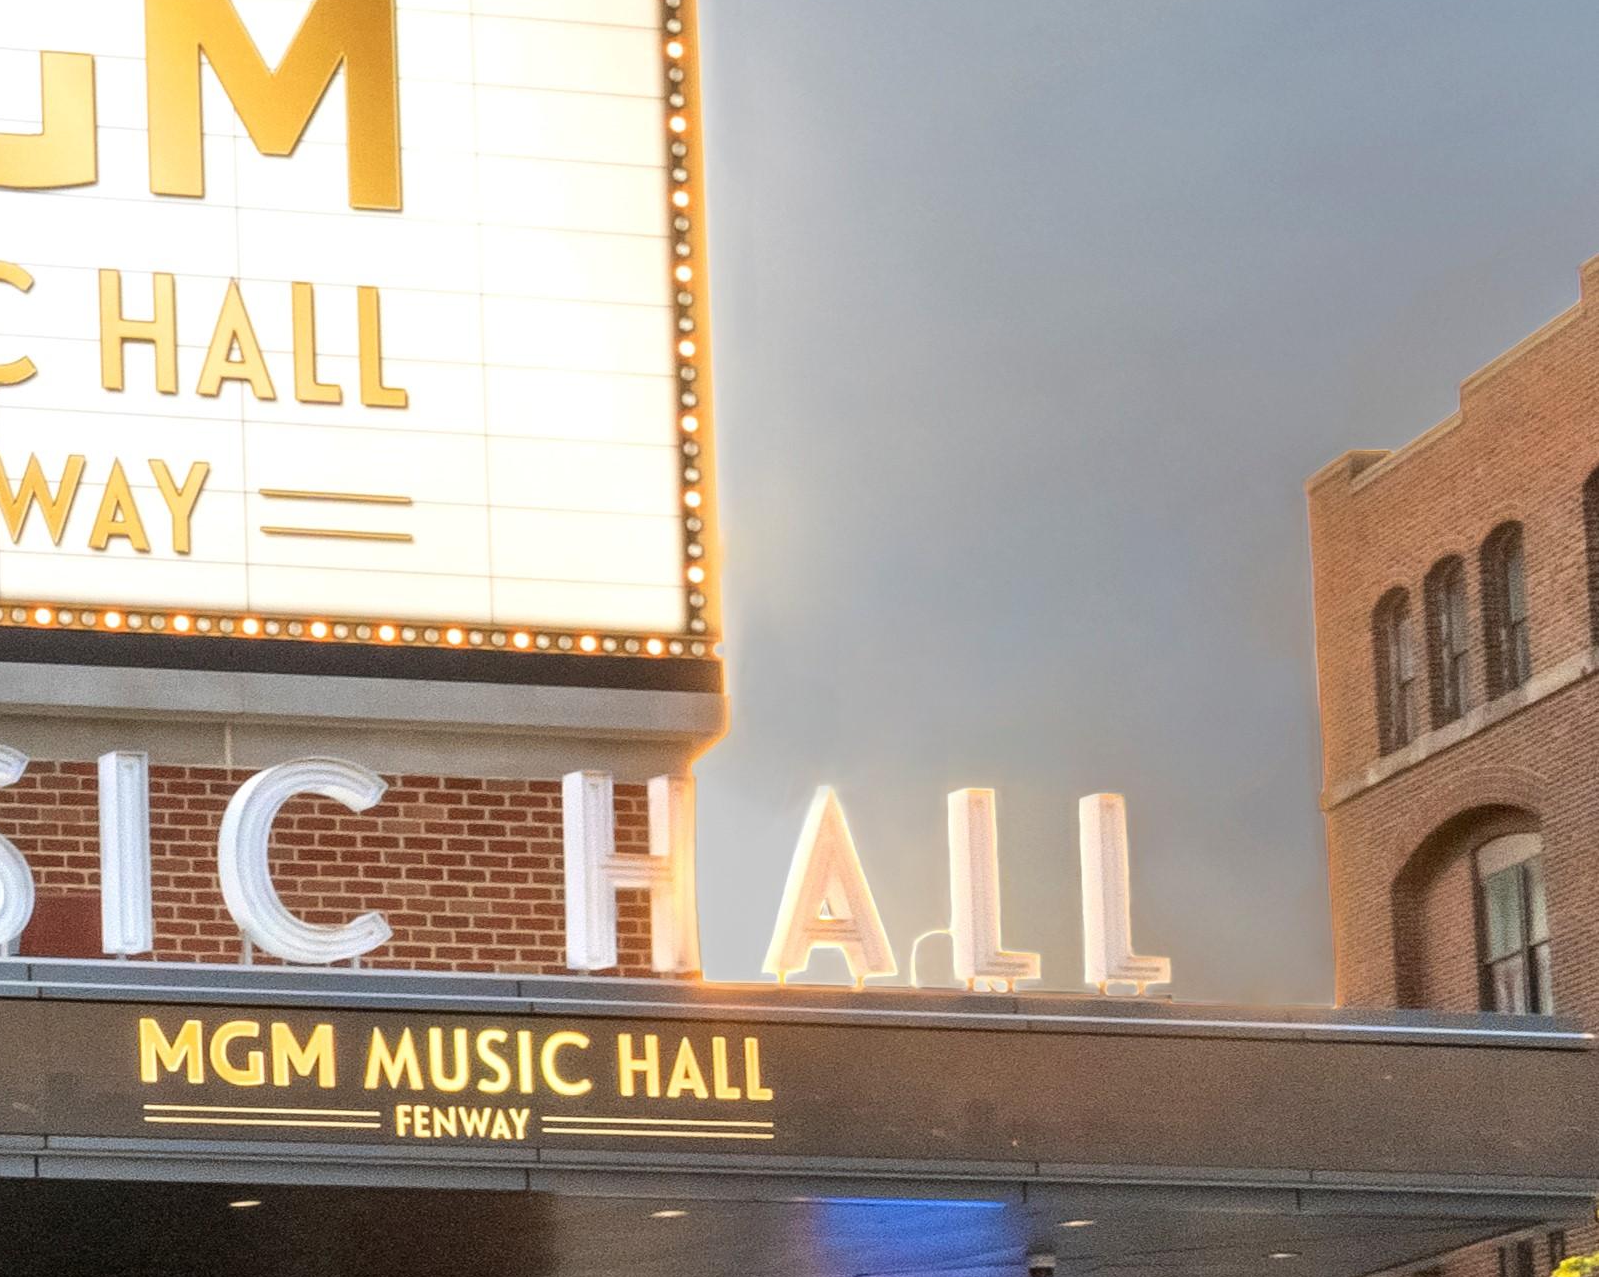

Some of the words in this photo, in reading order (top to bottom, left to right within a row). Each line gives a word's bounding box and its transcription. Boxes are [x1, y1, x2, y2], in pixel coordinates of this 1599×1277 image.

[98, 268, 411, 412] HALL
[560, 767, 1175, 994] HALL
[138, 1017, 336, 1089] MGM
[364, 1025, 593, 1097] MUSIC
[618, 1033, 774, 1101] HALL
[395, 1103, 532, 1141] FENWAY
